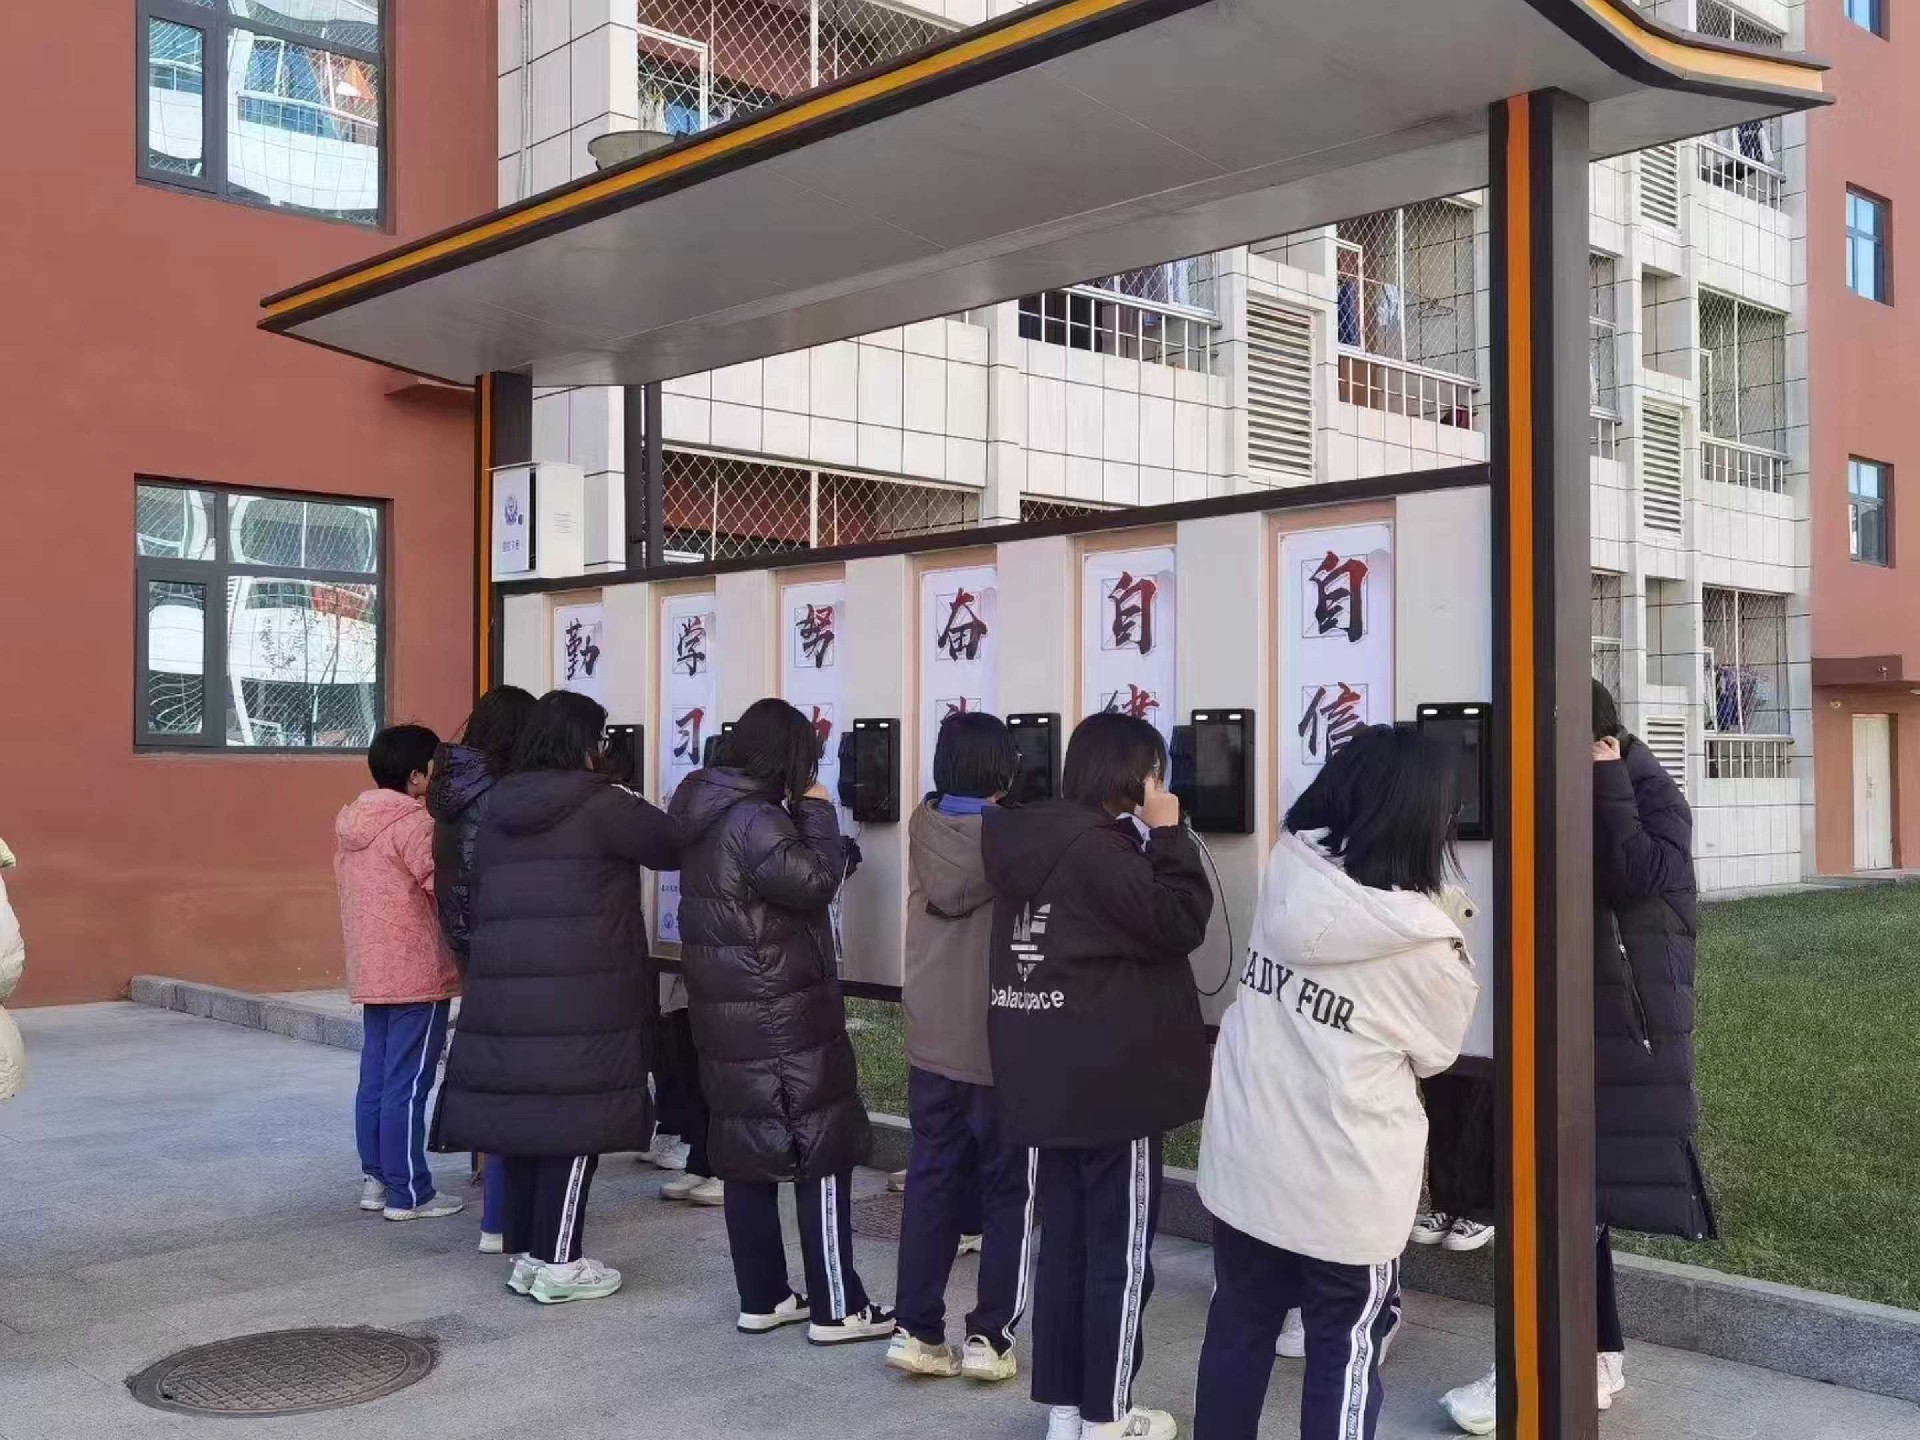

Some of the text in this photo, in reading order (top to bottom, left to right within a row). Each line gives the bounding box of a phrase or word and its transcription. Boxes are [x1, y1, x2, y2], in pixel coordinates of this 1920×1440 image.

[674, 615, 706, 765] 学习
[1298, 551, 1369, 757] 自信
[1240, 947, 1355, 1033] ADY FOR
